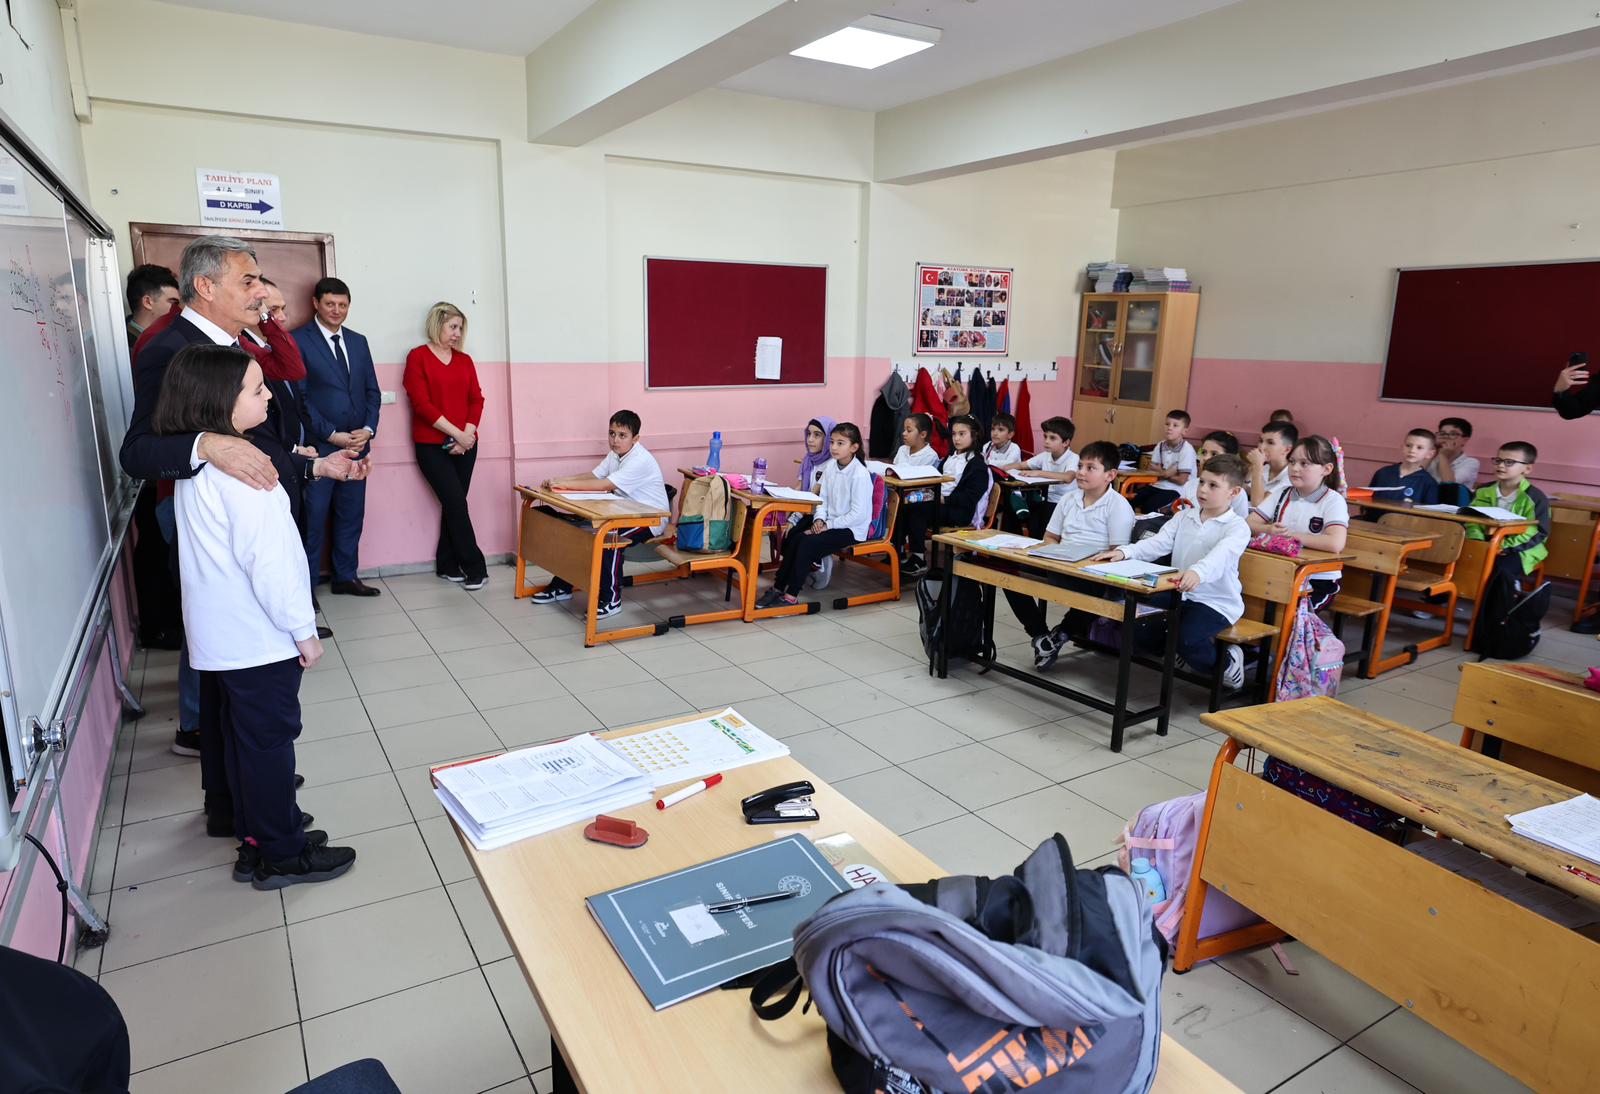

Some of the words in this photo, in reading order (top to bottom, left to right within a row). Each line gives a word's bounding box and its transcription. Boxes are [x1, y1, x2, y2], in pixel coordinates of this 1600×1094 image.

[205, 174, 244, 184] TAHLİYE
[246, 178, 272, 186] PLANI
[227, 202, 253, 210] KAPISI
